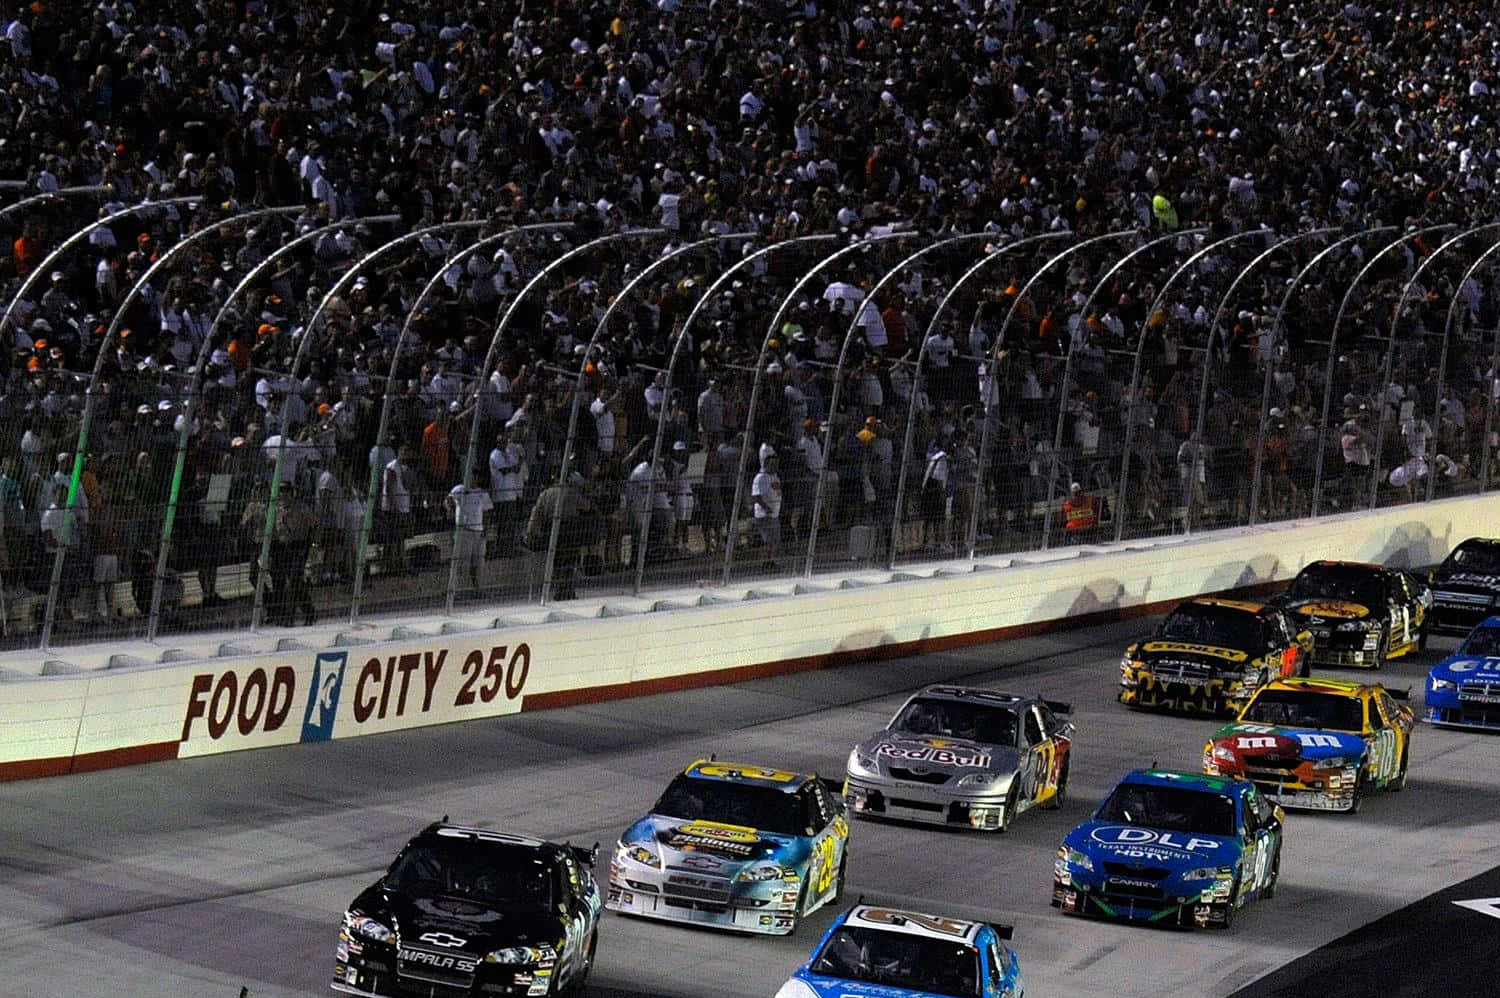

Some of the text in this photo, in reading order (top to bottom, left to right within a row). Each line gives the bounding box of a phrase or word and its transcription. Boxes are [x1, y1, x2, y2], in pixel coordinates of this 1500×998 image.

[181, 643, 532, 742] FOOD CITY 250
[873, 742, 991, 769] Red Bull
[672, 834, 753, 852] Platinum
[1118, 828, 1220, 851] DLP
[397, 949, 476, 973] IMPALA SS
